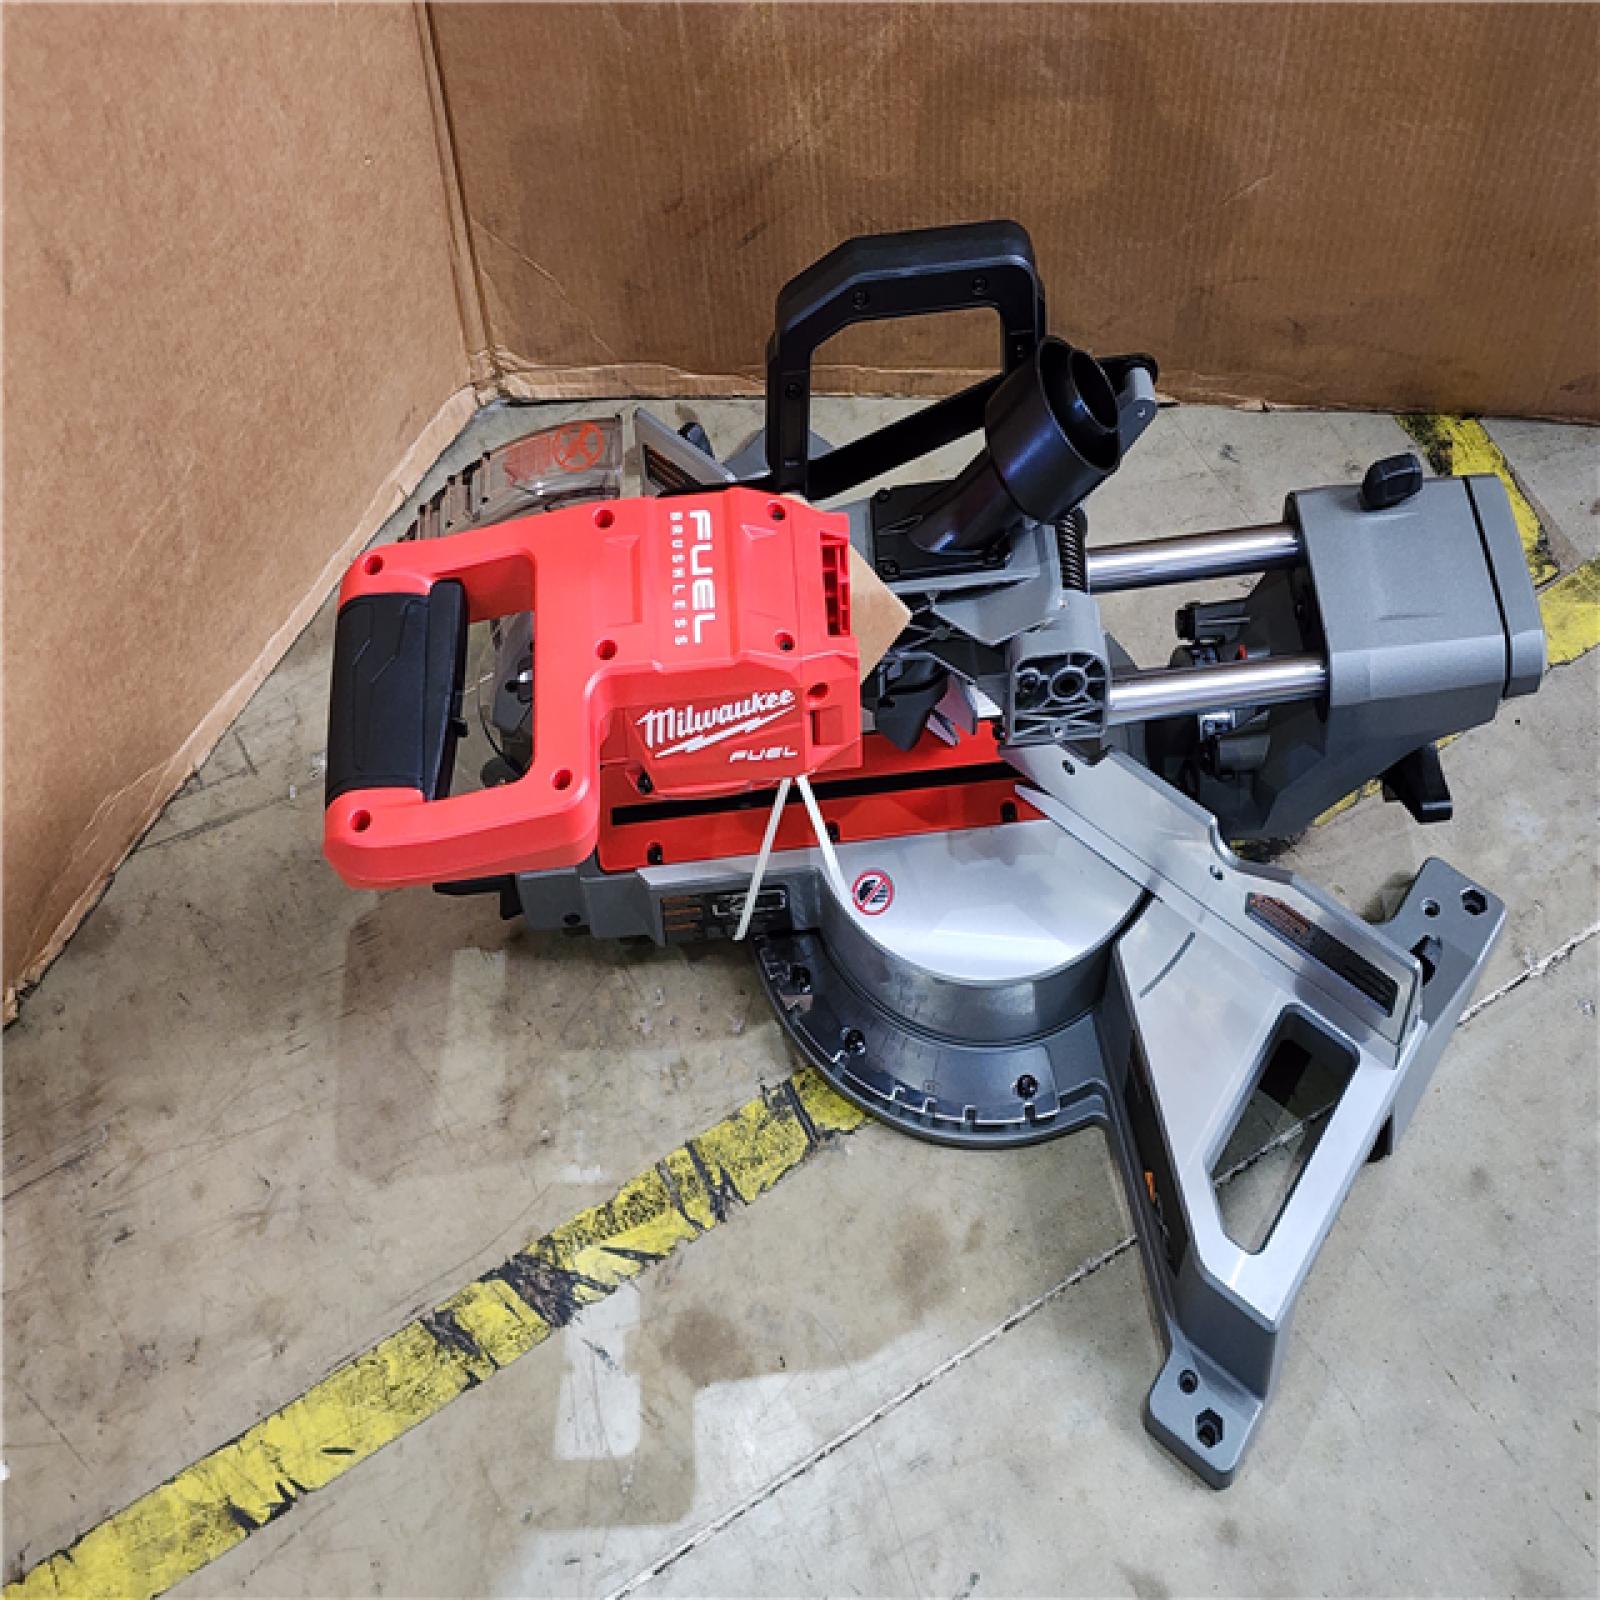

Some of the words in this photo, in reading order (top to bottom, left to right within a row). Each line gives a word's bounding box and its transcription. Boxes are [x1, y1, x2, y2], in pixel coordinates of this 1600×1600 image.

[669, 511, 689, 646] BRUSHLESS
[689, 509, 716, 644] FUEL
[634, 689, 795, 749] Milwaukee
[729, 746, 799, 763] FUEL
